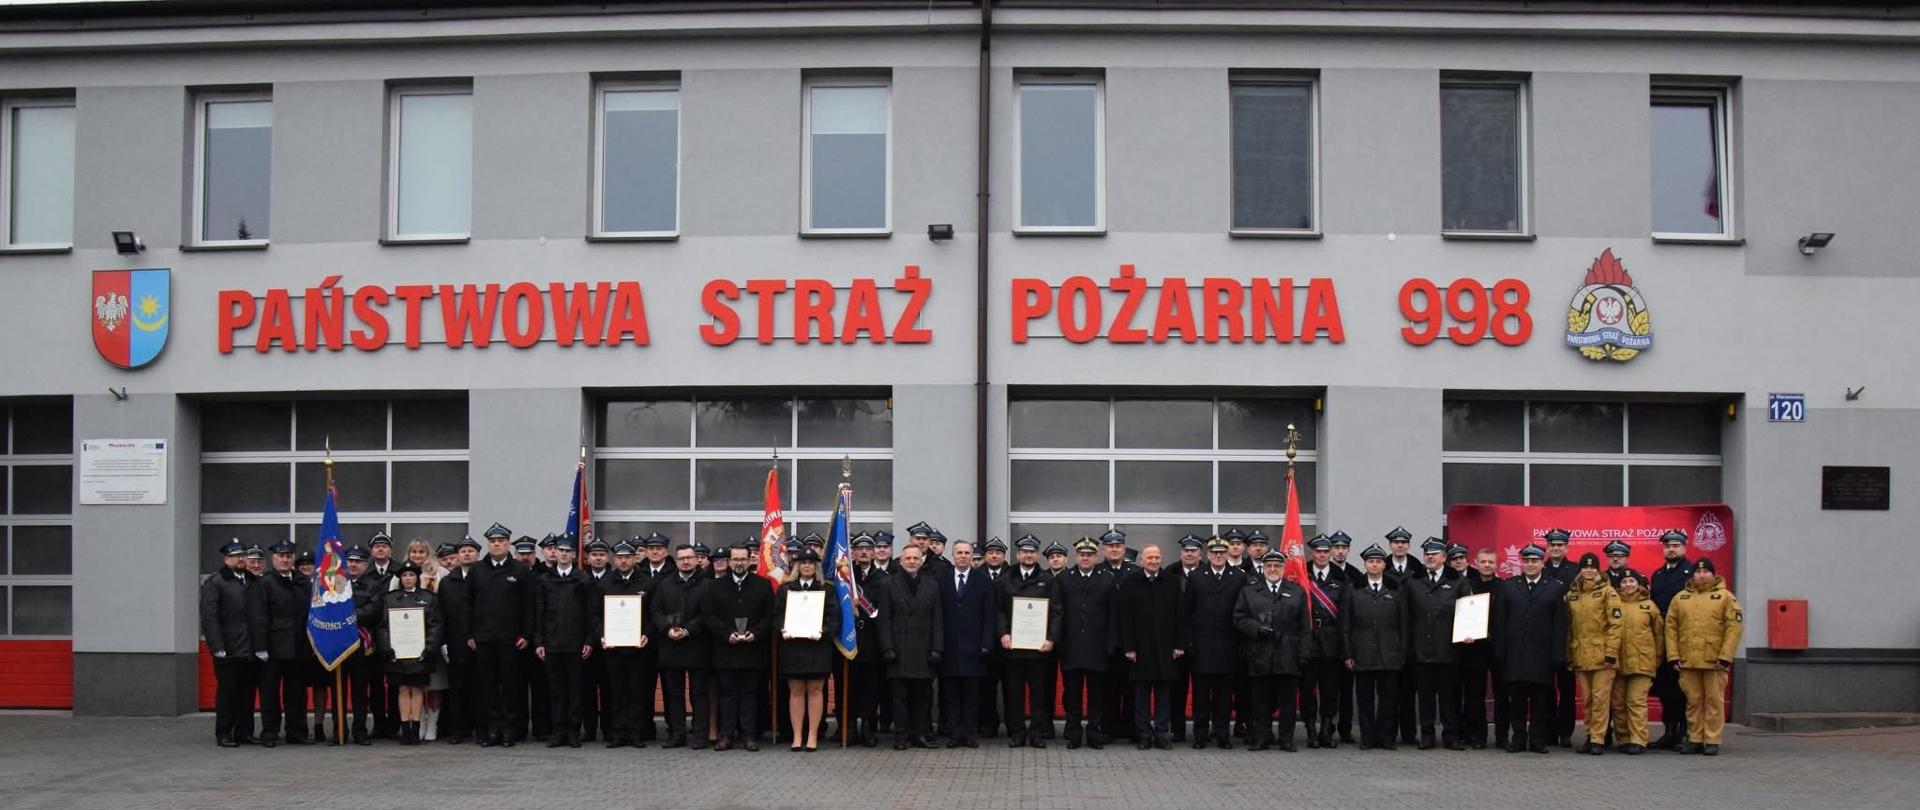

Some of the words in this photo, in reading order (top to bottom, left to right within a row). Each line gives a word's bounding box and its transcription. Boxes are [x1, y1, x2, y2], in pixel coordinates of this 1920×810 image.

[218, 274, 650, 353] PAŃSTWOWA
[699, 265, 932, 346] STRAŻ
[1011, 264, 1345, 344] POŻARNA
[1399, 278, 1533, 346] 998
[1771, 401, 1802, 420] 120
[1533, 527, 1599, 538] PAWOWA
[1601, 527, 1634, 538] STRAŻ
[1637, 527, 1687, 538] POŻAA
